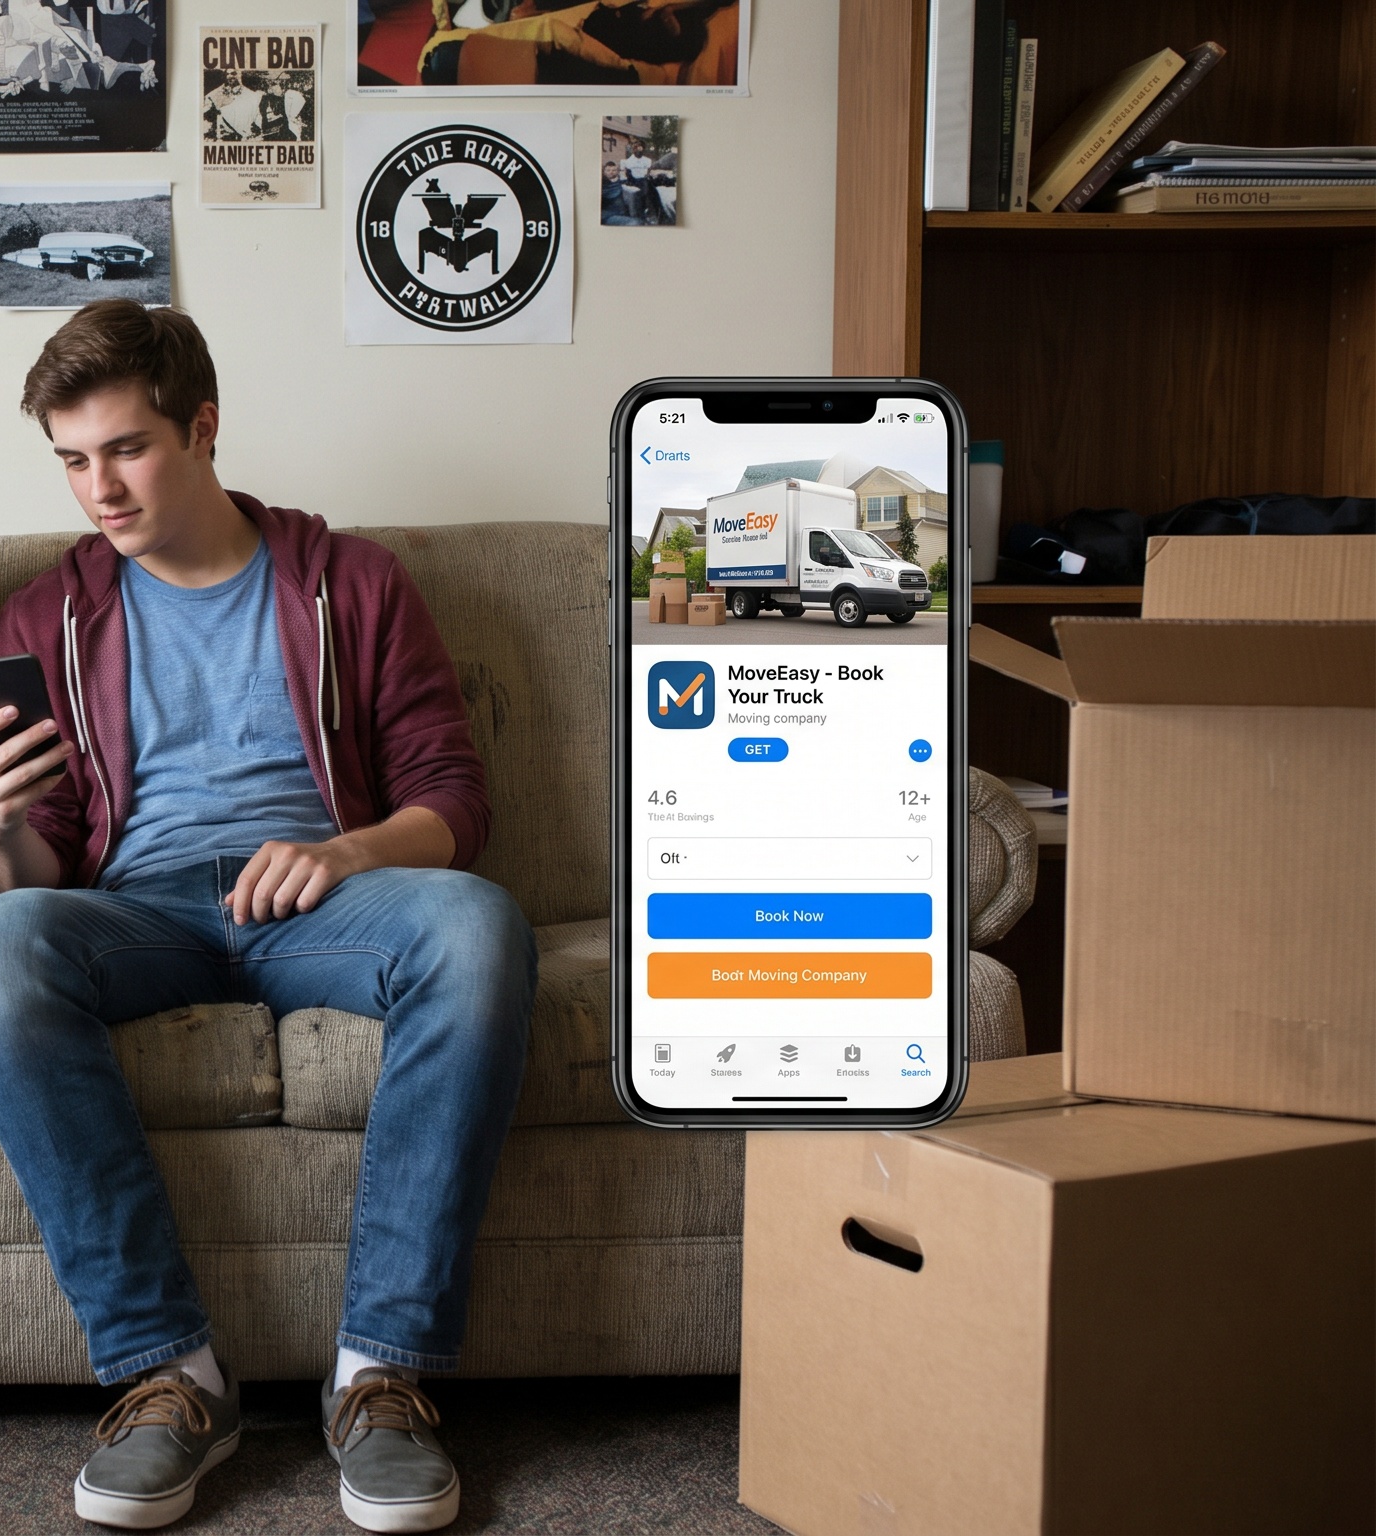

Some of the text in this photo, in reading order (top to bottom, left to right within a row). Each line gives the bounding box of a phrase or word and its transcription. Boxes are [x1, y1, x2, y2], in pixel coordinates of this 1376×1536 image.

[267, 36, 314, 69] BAD
[370, 220, 390, 237] 18
[525, 220, 549, 238] 36
[659, 413, 686, 424] 5:21
[713, 512, 779, 534] MoveEasy
[728, 665, 820, 684] MoveEasy
[838, 665, 884, 681] Book
[728, 689, 824, 704] Your Truck
[728, 713, 827, 727] Moving company
[744, 744, 771, 755] GET
[648, 790, 678, 806] 4.6
[898, 790, 932, 806] 12+
[908, 812, 927, 823] Age
[755, 910, 824, 922] Book Now
[748, 969, 798, 984] Moving
[801, 969, 867, 984] Company
[649, 1069, 676, 1079] Today
[777, 1069, 800, 1079] Apps
[900, 1068, 932, 1077] Search
